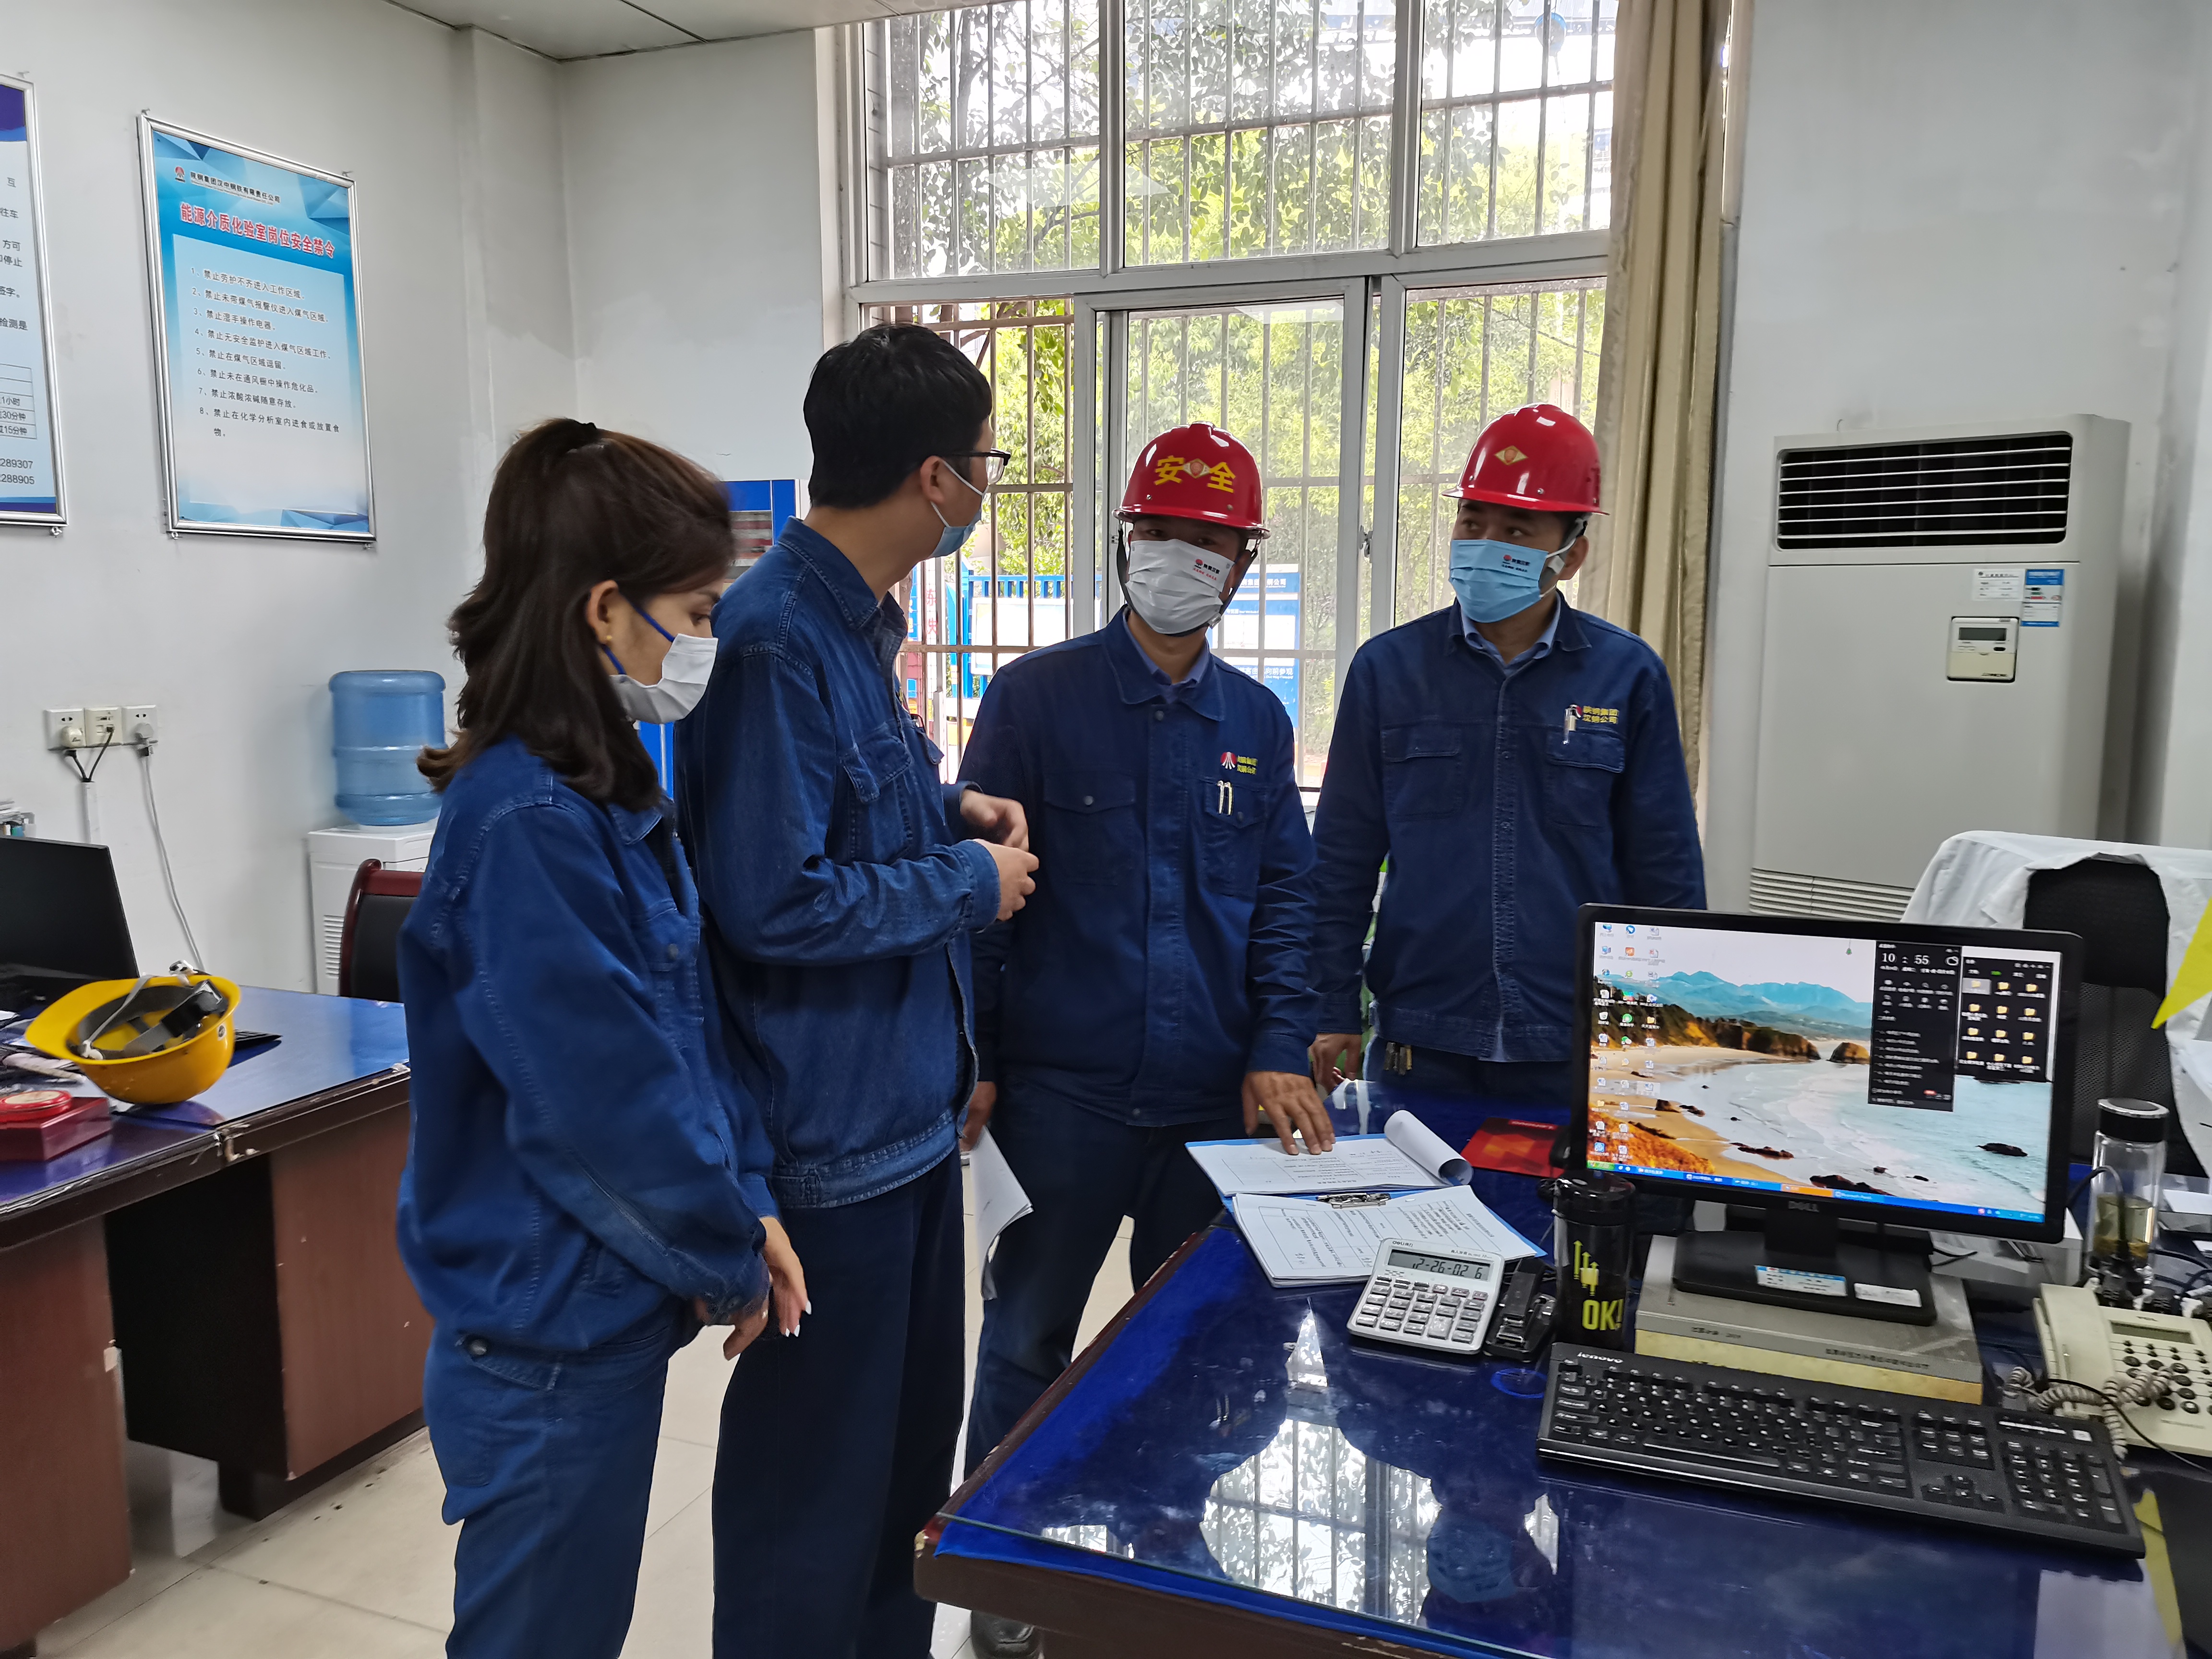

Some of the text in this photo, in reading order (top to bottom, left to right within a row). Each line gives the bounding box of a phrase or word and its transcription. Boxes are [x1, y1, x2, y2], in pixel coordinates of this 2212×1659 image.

[7, 177, 16, 188] 互
[180, 202, 335, 258] 能源介质化验室岗位安全禁令
[2, 240, 21, 251] 方可
[0, 254, 23, 267] 停止
[1582, 1299, 1624, 1331] OK!
[1577, 1352, 1623, 1363] lenovo
